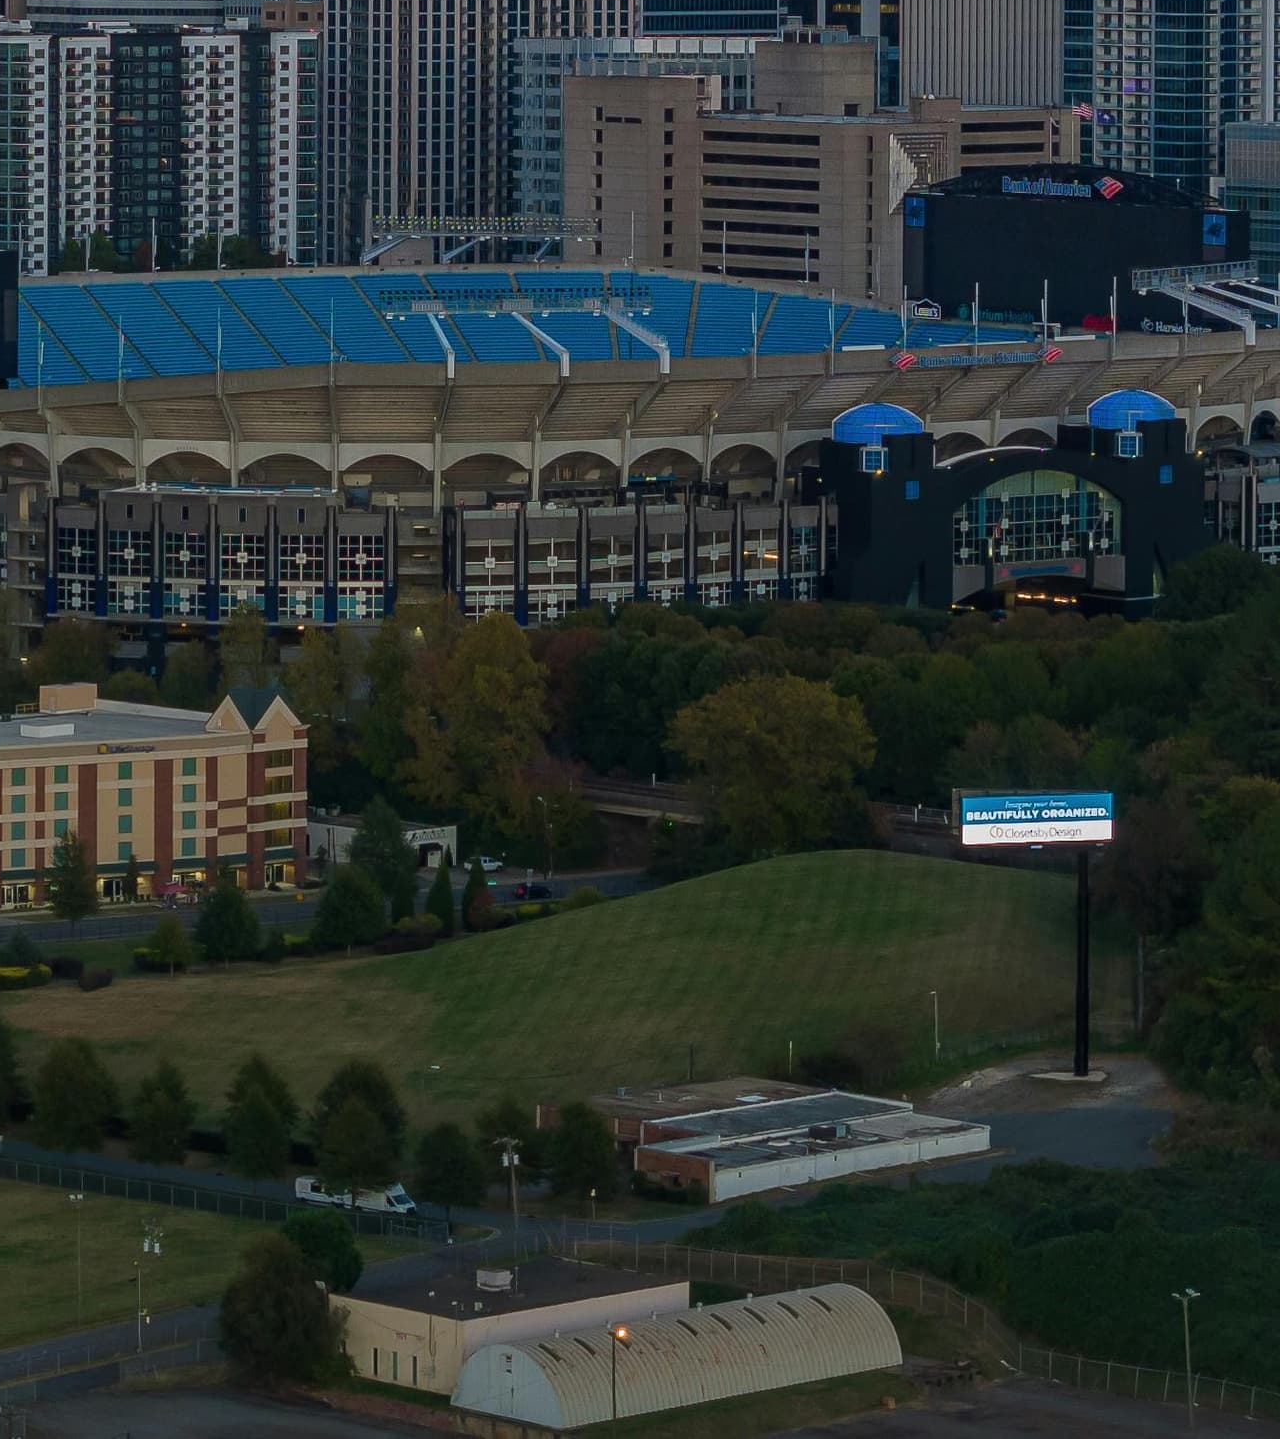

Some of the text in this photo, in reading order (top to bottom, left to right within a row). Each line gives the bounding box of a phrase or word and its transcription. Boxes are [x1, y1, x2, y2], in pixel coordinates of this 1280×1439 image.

[1001, 175, 1092, 198] Bank of America
[975, 309, 1004, 321] trium
[1033, 801, 1048, 809] your
[966, 807, 1109, 821] BEAUTIFULLY ORGANIZED.
